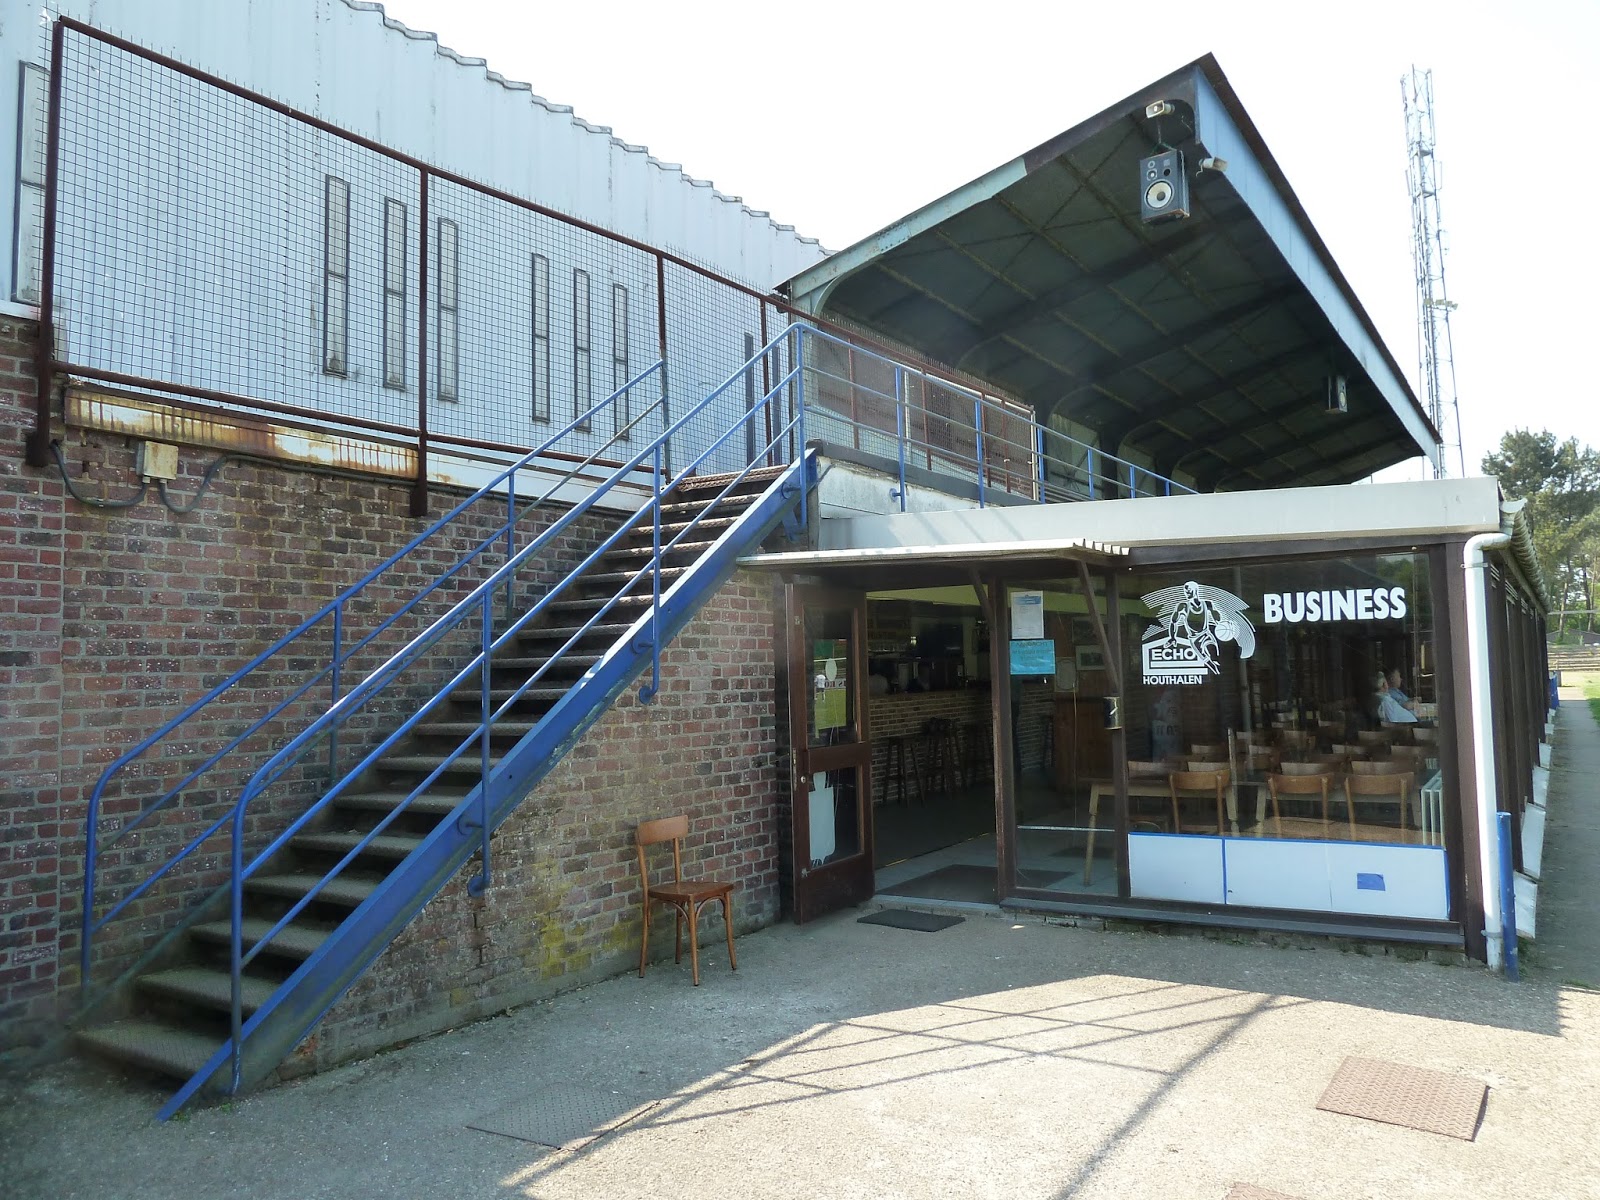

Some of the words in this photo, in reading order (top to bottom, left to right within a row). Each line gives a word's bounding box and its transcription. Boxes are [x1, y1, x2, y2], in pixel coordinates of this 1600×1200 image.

[1263, 587, 1407, 623] BUSINESS
[1151, 648, 1196, 661] ECHO
[1142, 675, 1203, 685] HOUTHALEN
